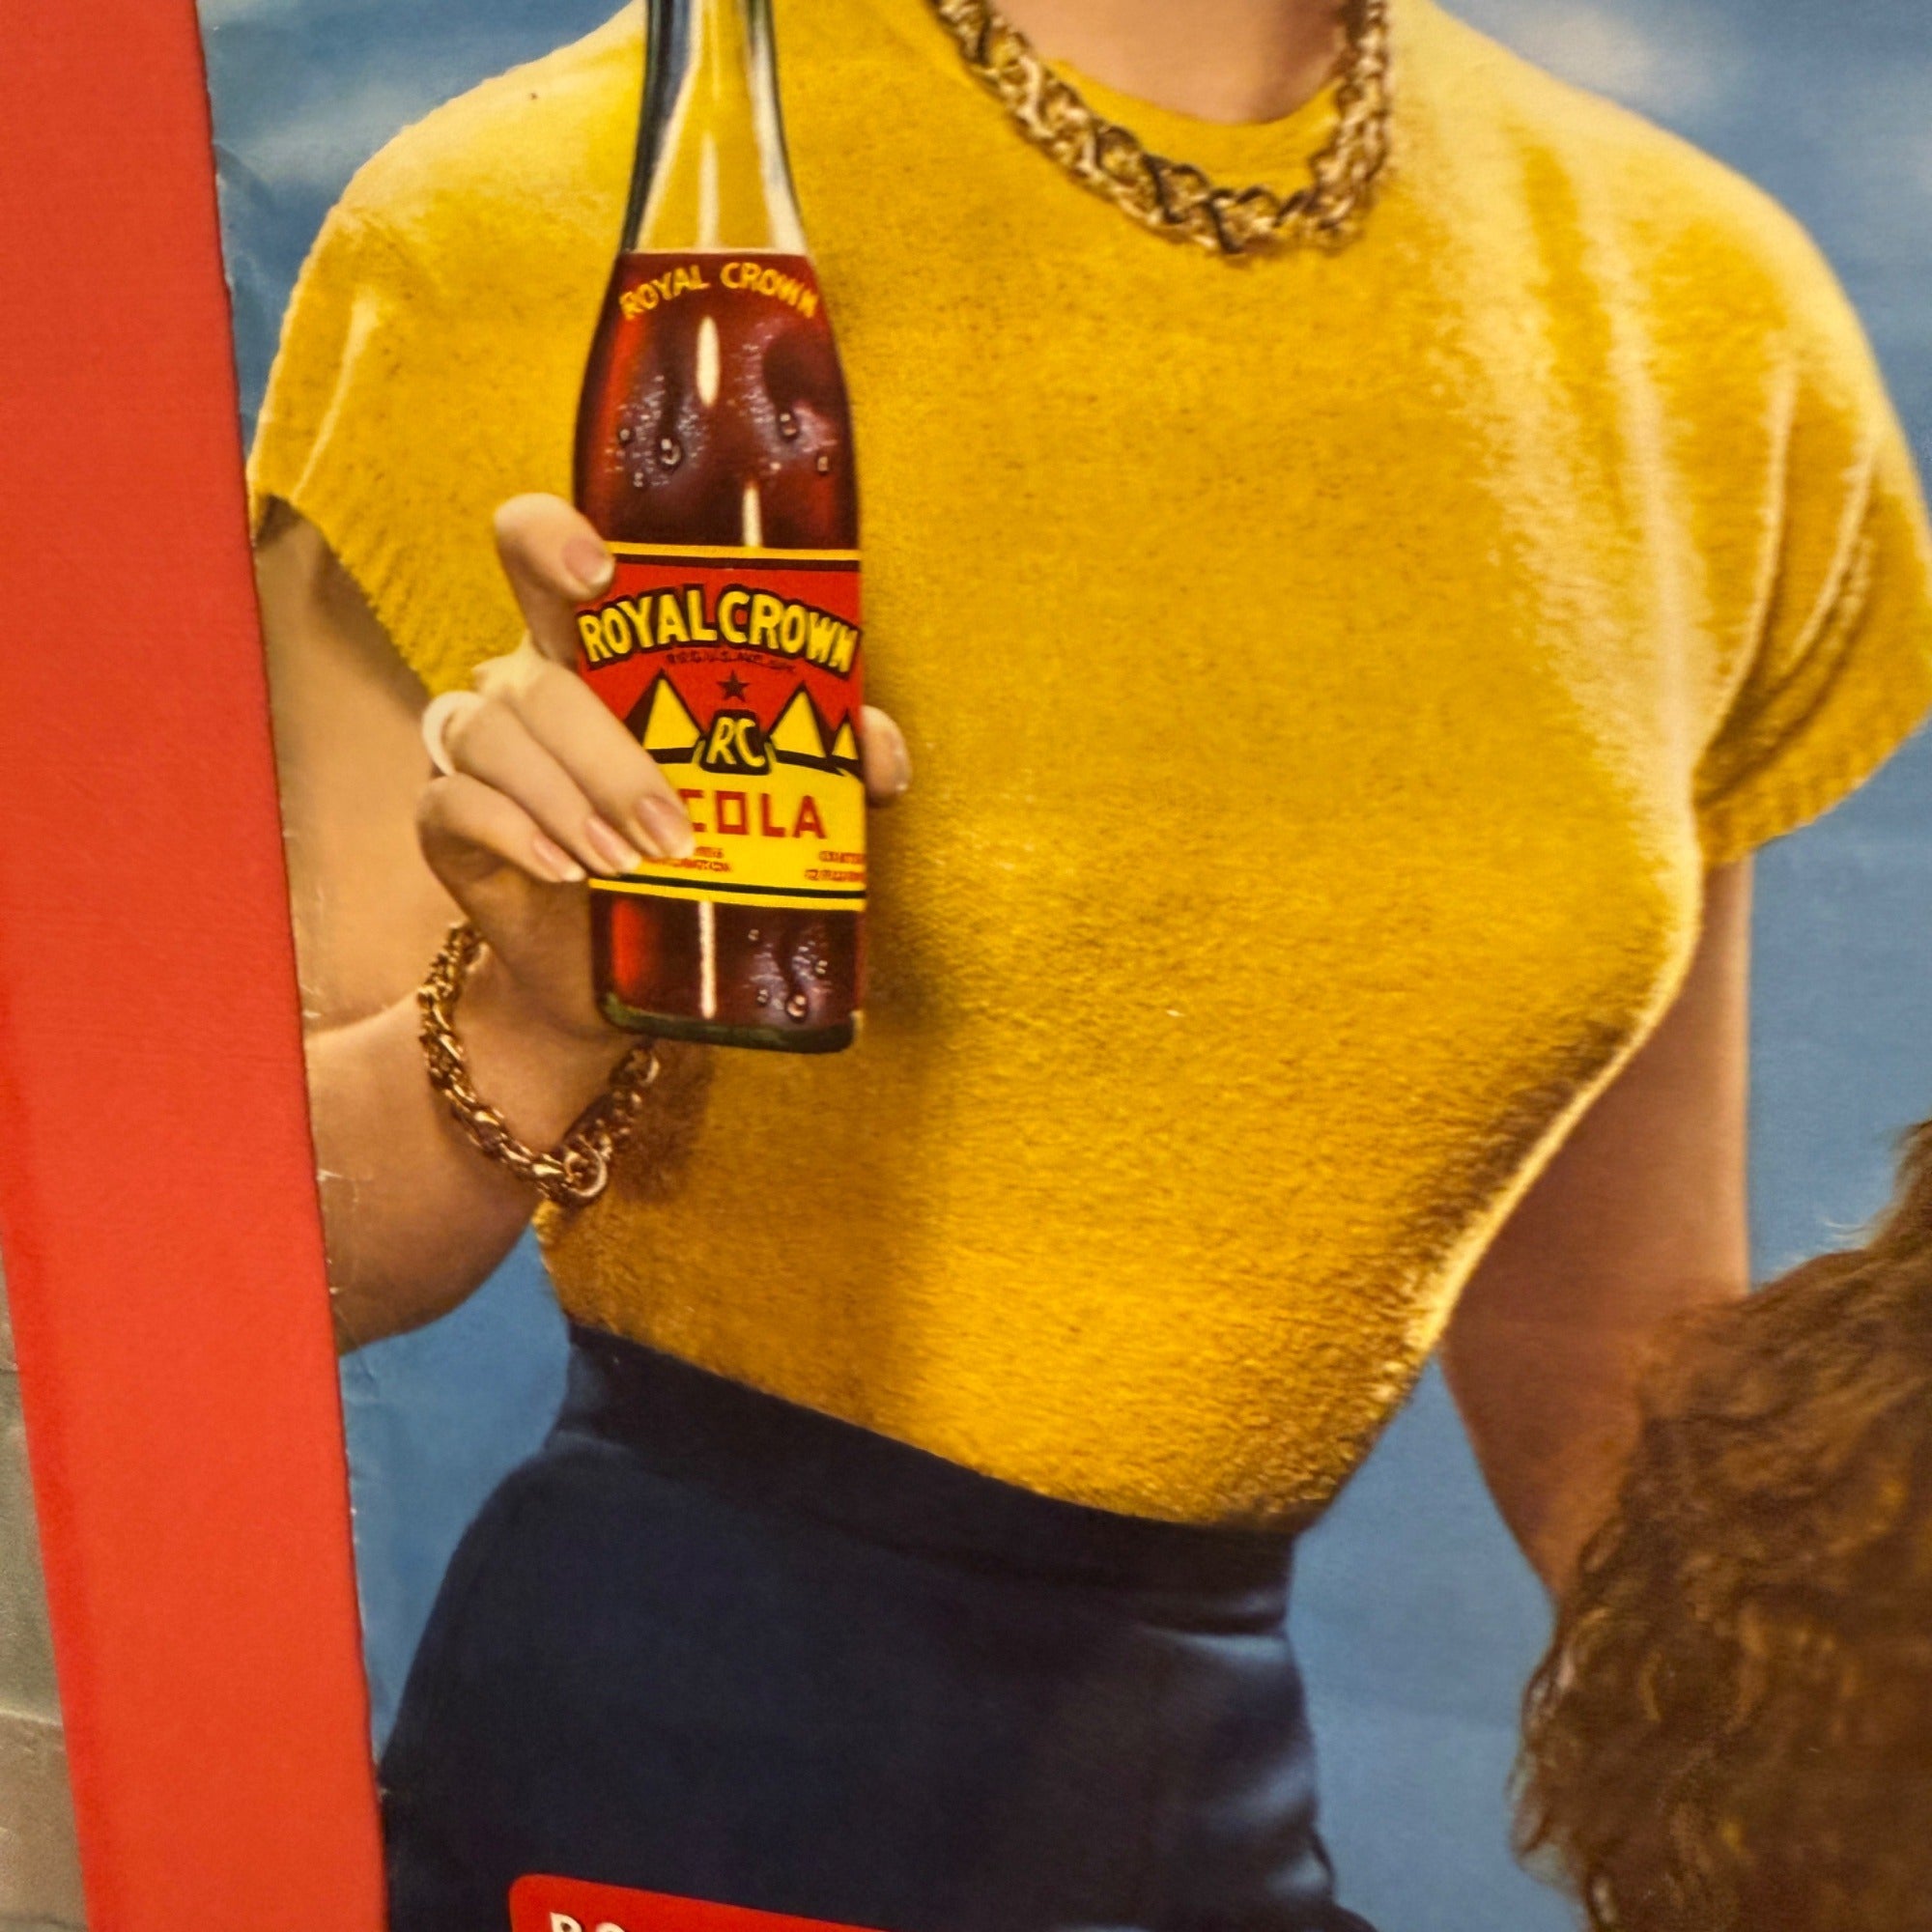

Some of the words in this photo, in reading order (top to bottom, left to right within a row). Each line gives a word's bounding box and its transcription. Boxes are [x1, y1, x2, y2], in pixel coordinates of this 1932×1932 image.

[619, 265, 711, 320] ROYAL
[720, 262, 819, 318] CROWN
[577, 586, 718, 666] ROYAL
[718, 587, 859, 675] CROWN
[705, 716, 767, 768] RC
